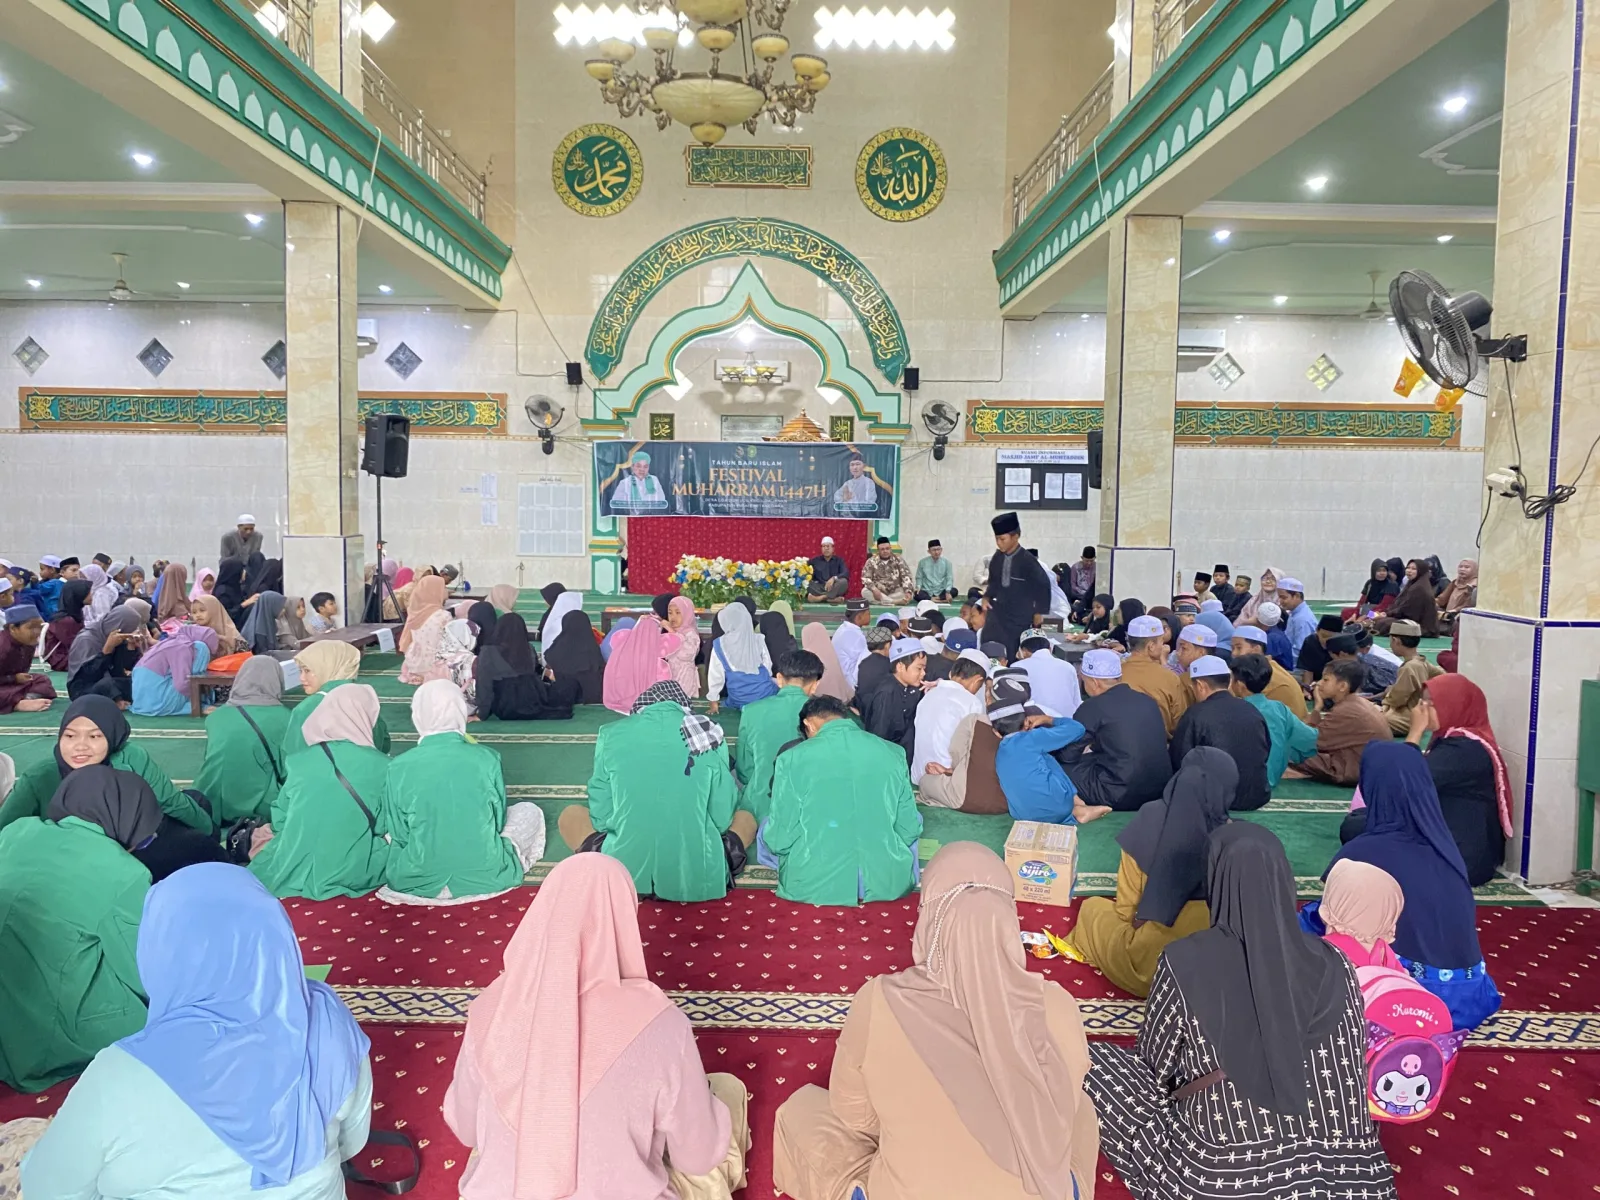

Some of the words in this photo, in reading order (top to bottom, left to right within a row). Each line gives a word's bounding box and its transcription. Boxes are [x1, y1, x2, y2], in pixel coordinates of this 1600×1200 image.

[709, 467, 787, 482] FESTIVAL
[672, 481, 776, 497] MUHARRAM
[779, 484, 827, 499] 1447H
[1020, 865, 1051, 878] Sijiro
[1392, 1003, 1434, 1022] Kuromi
